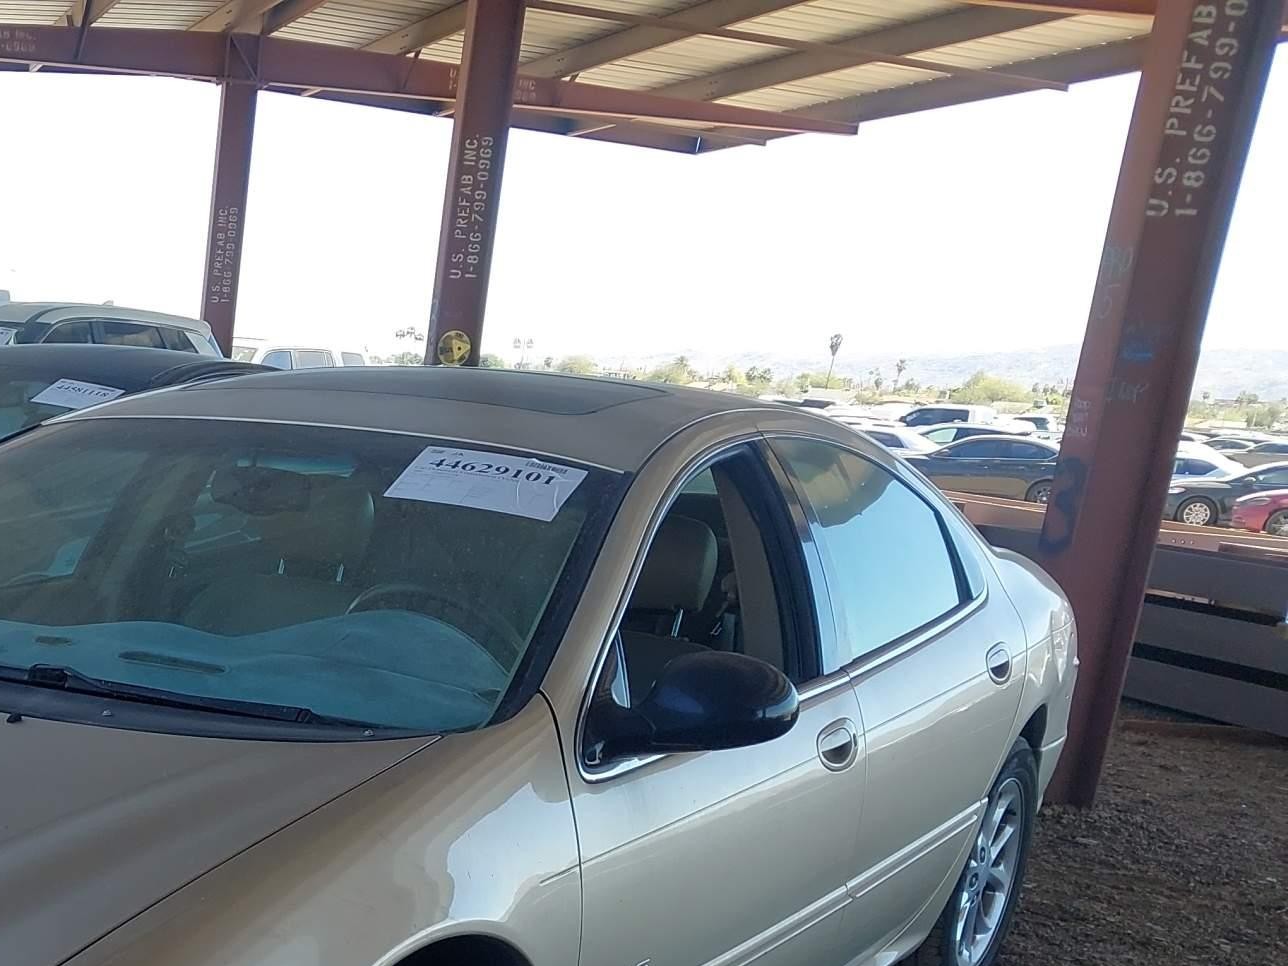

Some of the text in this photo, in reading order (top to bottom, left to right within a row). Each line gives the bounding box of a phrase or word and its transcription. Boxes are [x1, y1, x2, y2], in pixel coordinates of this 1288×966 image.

[1146, 5, 1217, 217] U.S. PREFAB
[213, 232, 226, 277] PREFAB
[449, 133, 480, 280] U.S. PREFAB INC.
[464, 136, 494, 279] 1-866-799-0969
[429, 458, 557, 486] 44629101
